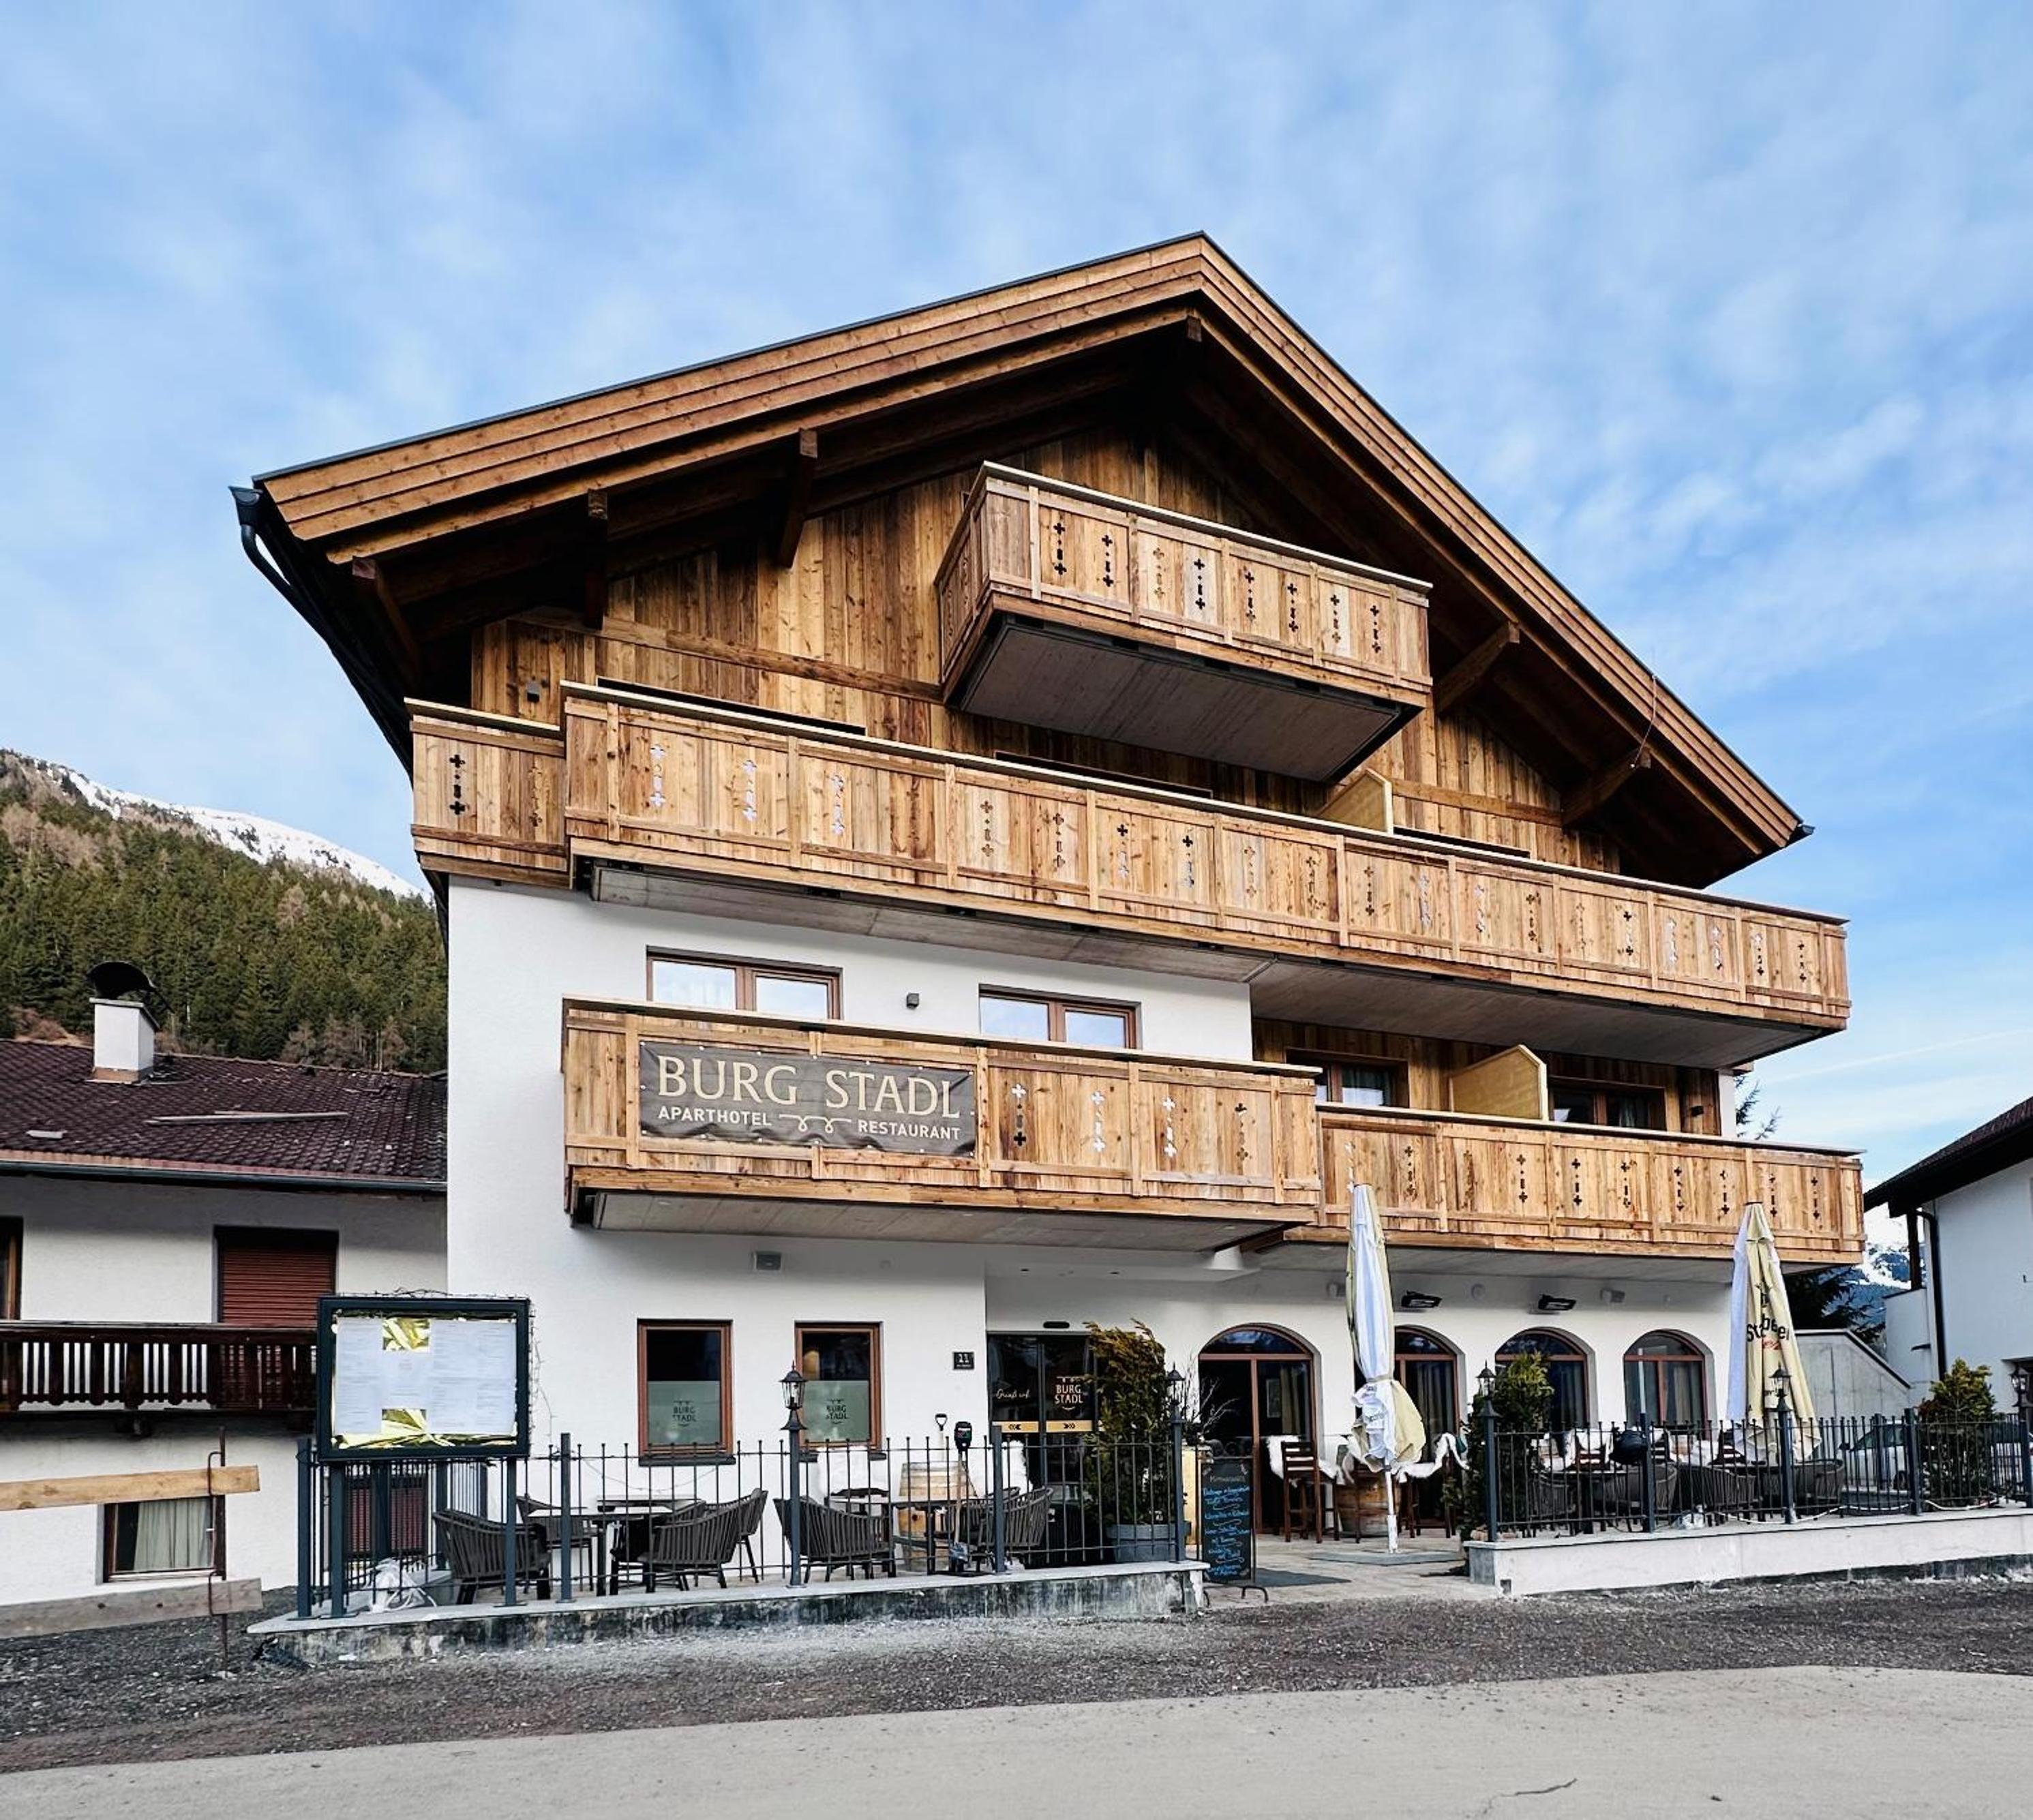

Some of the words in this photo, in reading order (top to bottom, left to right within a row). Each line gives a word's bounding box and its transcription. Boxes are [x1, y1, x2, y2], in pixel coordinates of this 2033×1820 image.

[658, 1055, 797, 1106] BURG
[825, 1070, 960, 1119] STADL
[658, 1106, 772, 1127] APARTHOTEL
[858, 1119, 961, 1140] RESTAURANT
[1055, 1384, 1081, 1394] BURG
[1055, 1394, 1083, 1404] STADL
